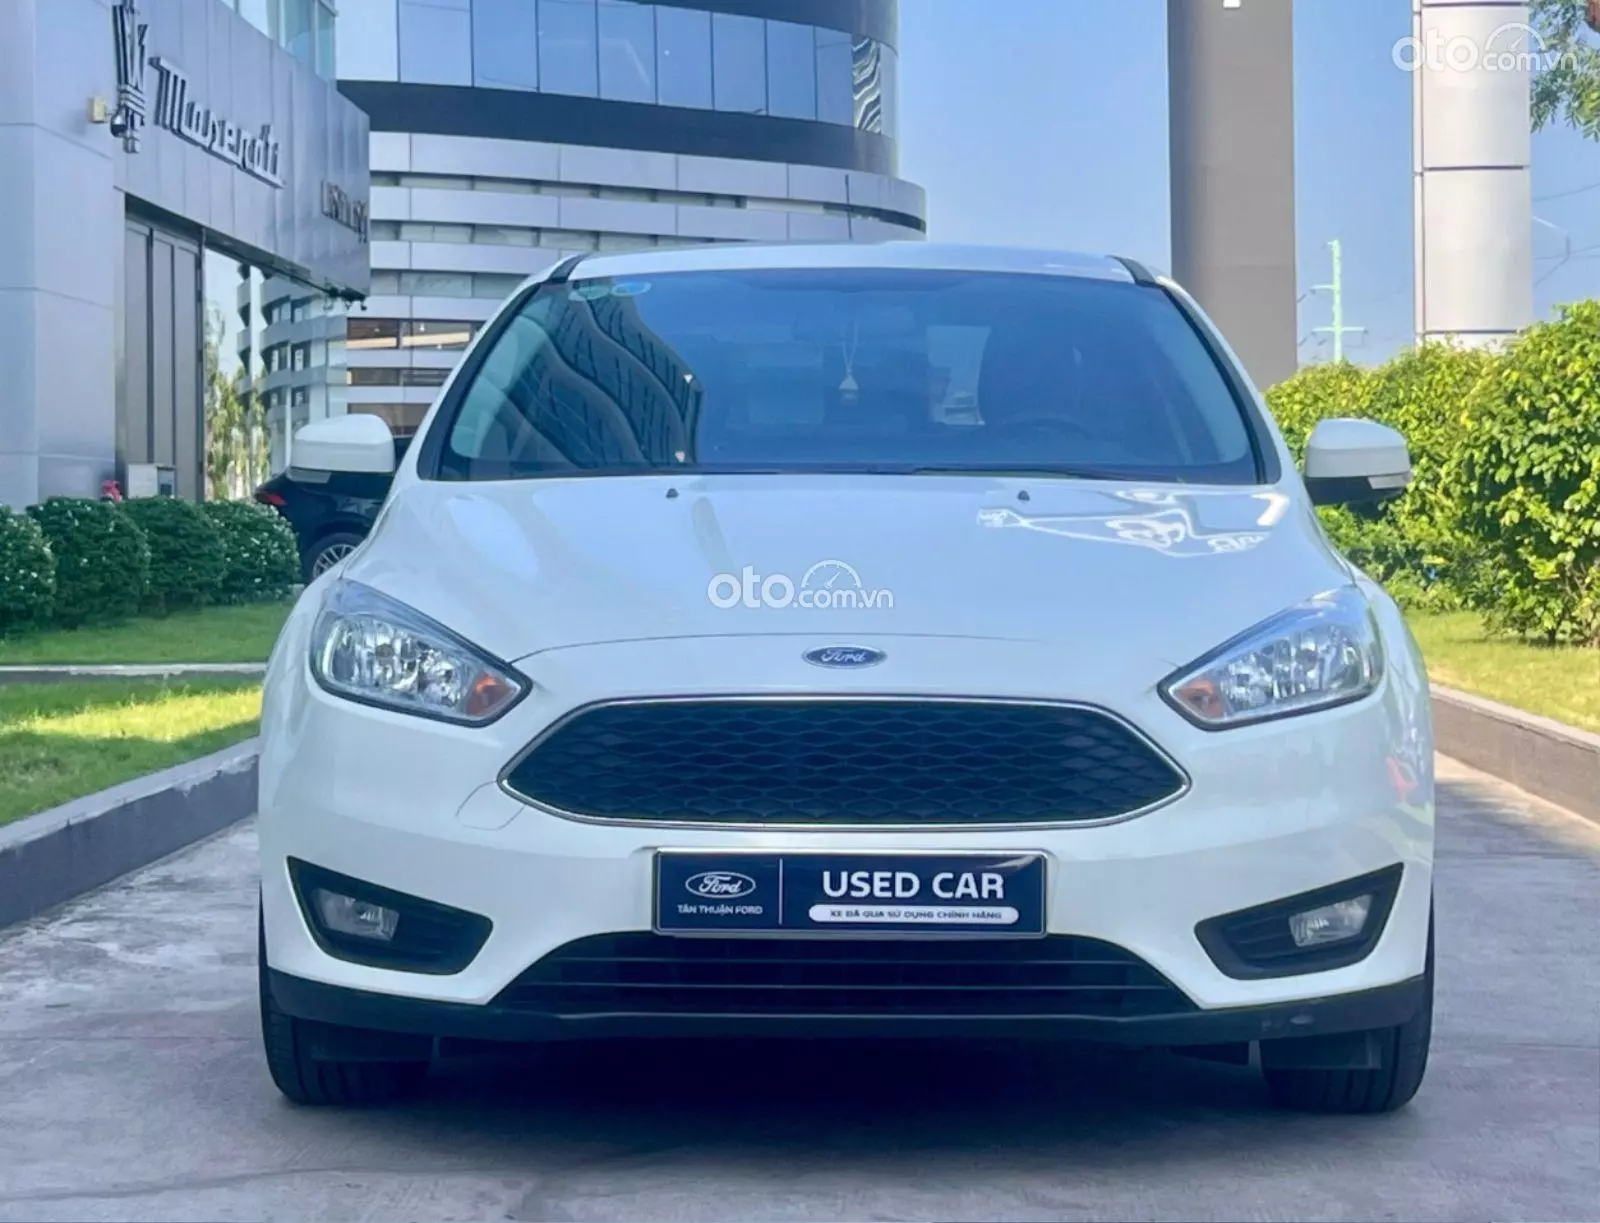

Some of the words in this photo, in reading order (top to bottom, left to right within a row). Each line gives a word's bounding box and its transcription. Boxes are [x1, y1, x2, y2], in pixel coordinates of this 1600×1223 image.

[699, 875, 742, 893] Ford
[823, 871, 920, 898] USED
[932, 872, 1004, 899] CAR
[735, 905, 763, 915] FORD
[830, 910, 842, 918] XE
[862, 910, 884, 919] QUA
